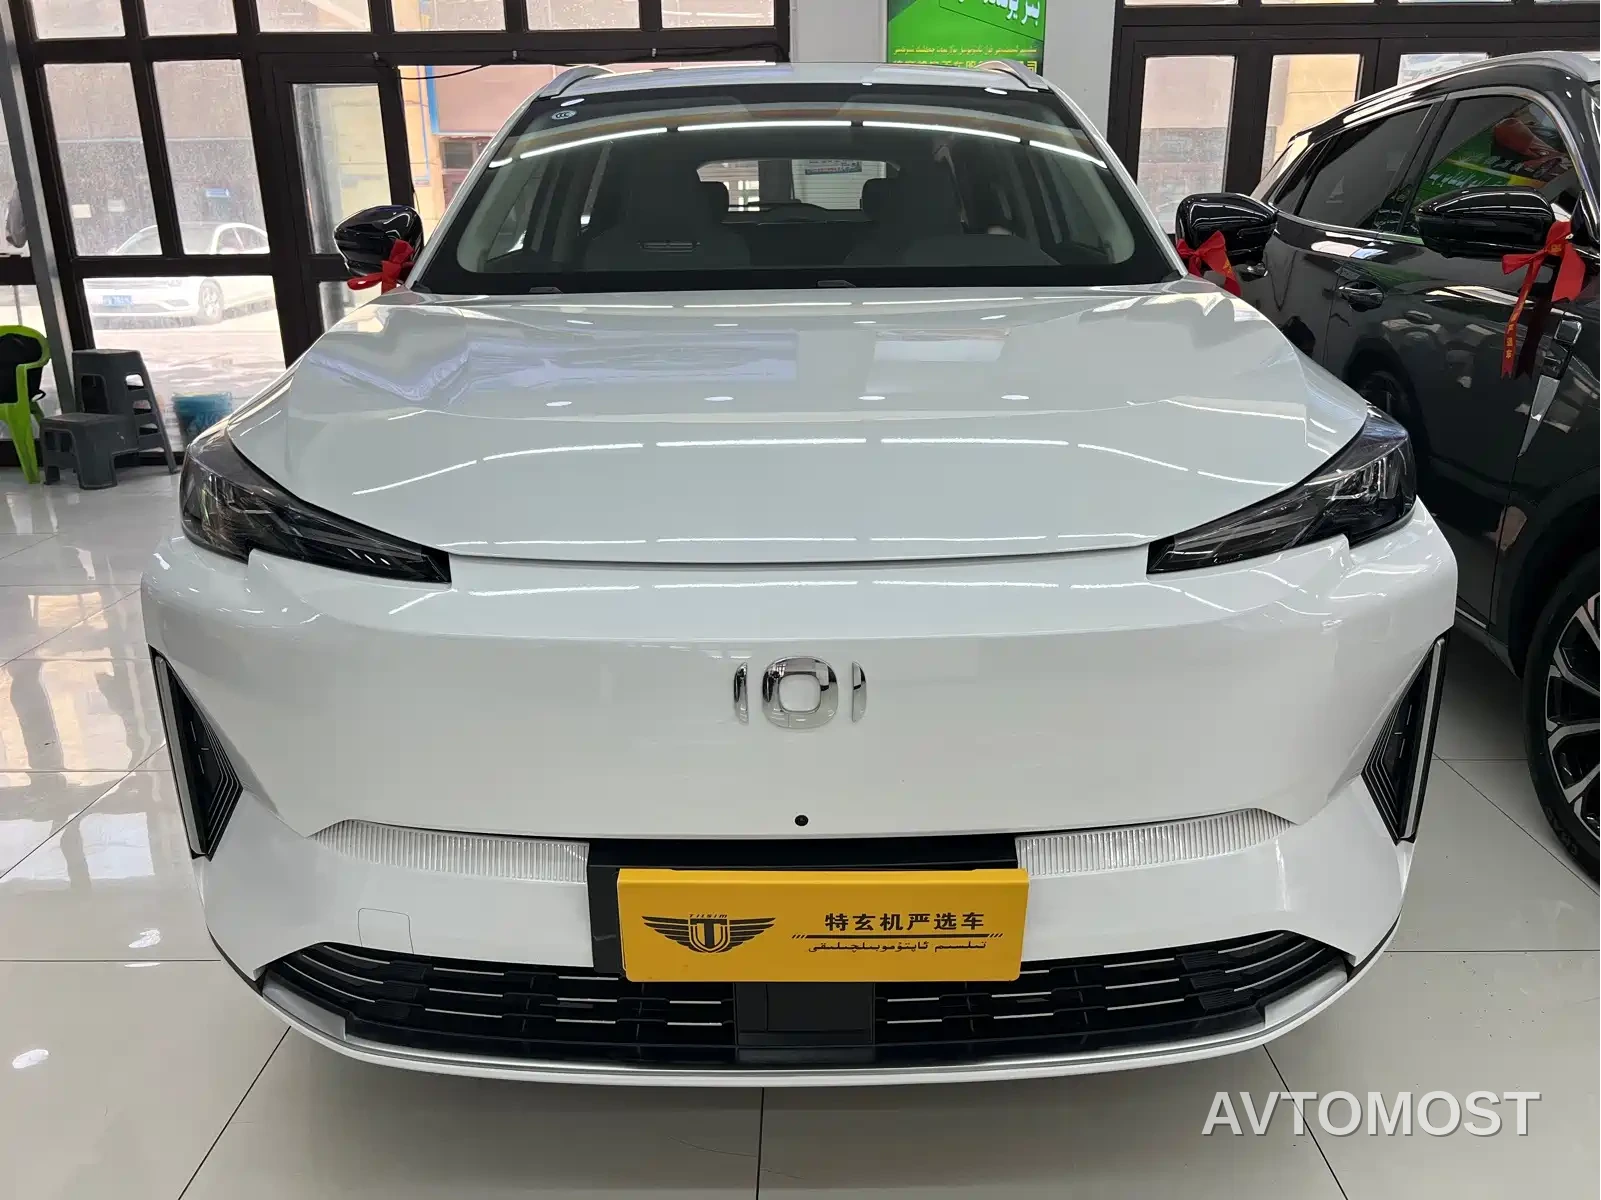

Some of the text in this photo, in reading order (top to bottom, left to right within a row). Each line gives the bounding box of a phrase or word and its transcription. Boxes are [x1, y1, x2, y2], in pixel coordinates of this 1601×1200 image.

[824, 912, 985, 931] 特玄机严选车
